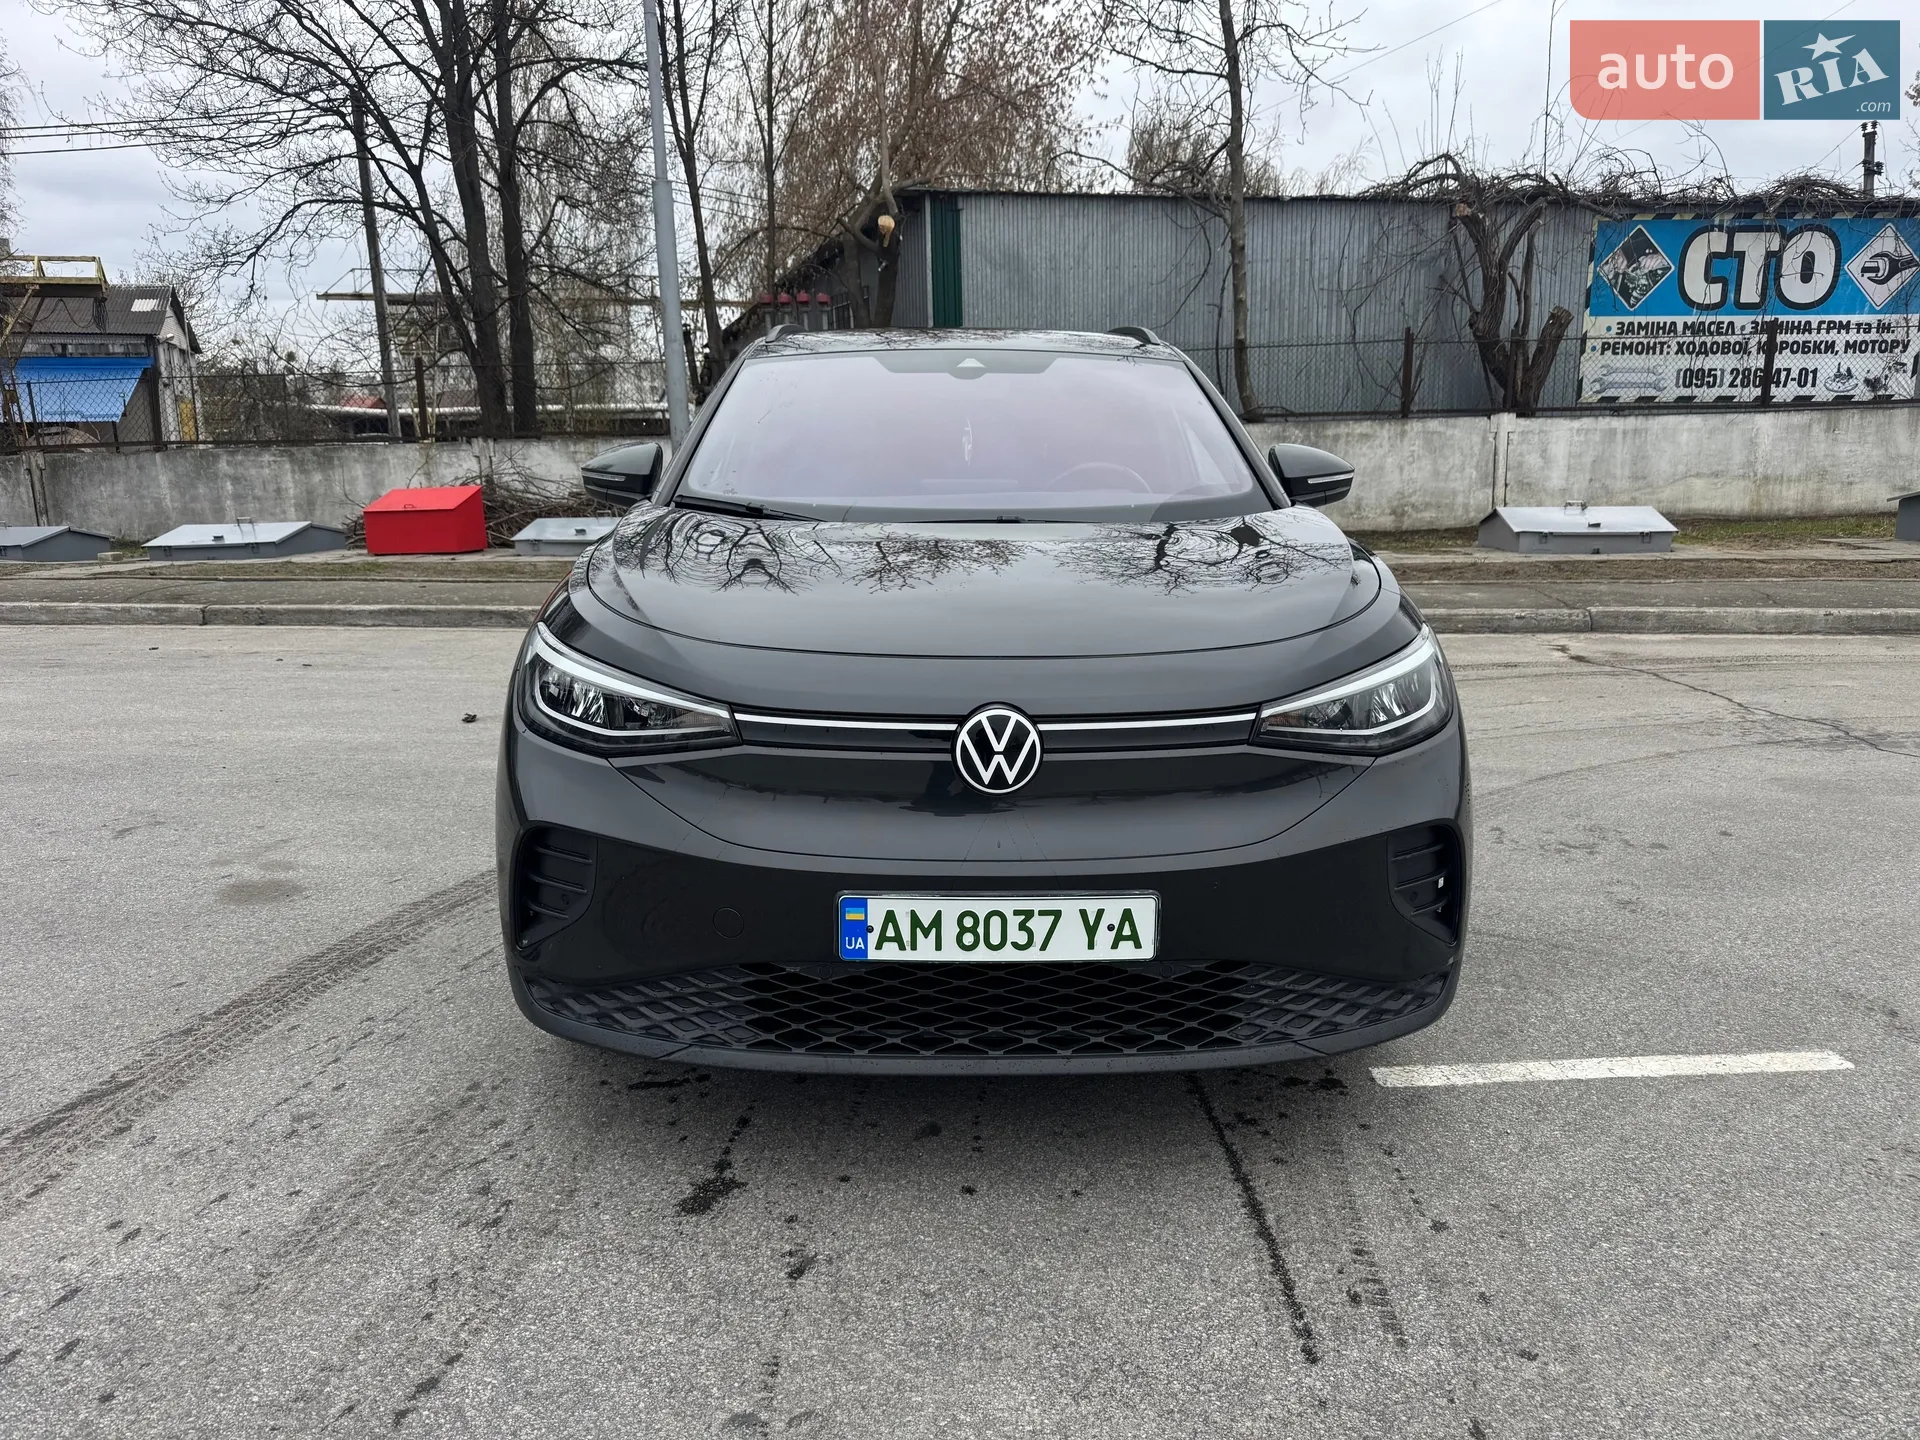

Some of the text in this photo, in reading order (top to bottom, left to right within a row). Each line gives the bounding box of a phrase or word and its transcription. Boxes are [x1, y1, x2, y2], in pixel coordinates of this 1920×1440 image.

[1678, 224, 1841, 310] СТО
[1615, 321, 1678, 336] ЗАМІНА
[1681, 320, 1736, 336] МАСЕЛ
[1816, 320, 1851, 335] ГРМ
[1855, 322, 1873, 334] та
[1600, 338, 1911, 357] РЕМОНТ: ХОДОВОЇ, КРОБКИ, МОТОРУ
[874, 907, 1143, 952] AM 8037 YA
[845, 937, 865, 950] UA
